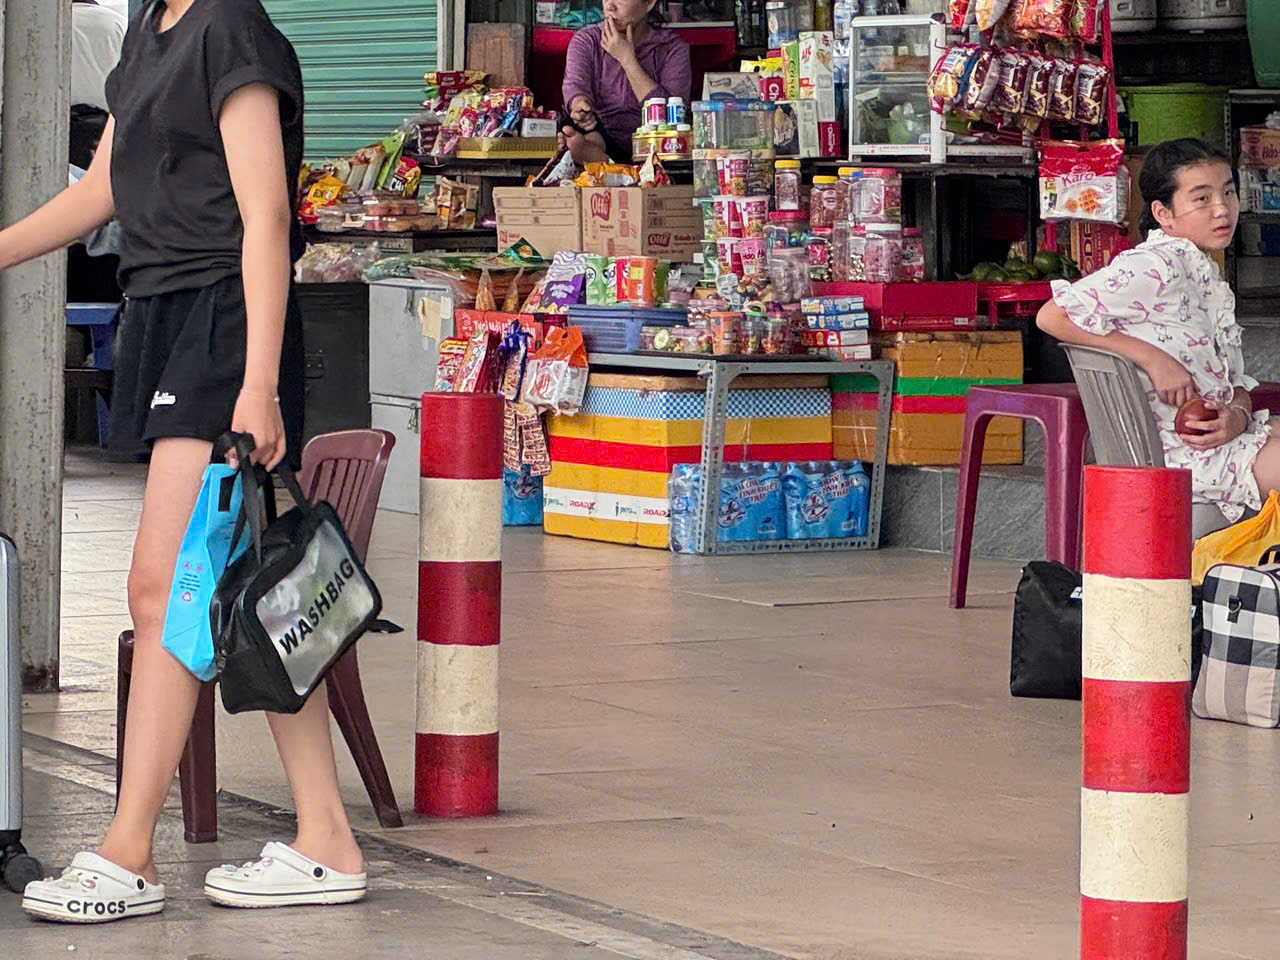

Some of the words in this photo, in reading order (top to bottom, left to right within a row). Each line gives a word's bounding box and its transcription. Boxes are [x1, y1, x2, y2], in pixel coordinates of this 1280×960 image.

[1061, 171, 1096, 187] Karo
[569, 500, 596, 515] ROADX
[279, 558, 355, 656] WASHBAG
[67, 900, 126, 916] crocs
